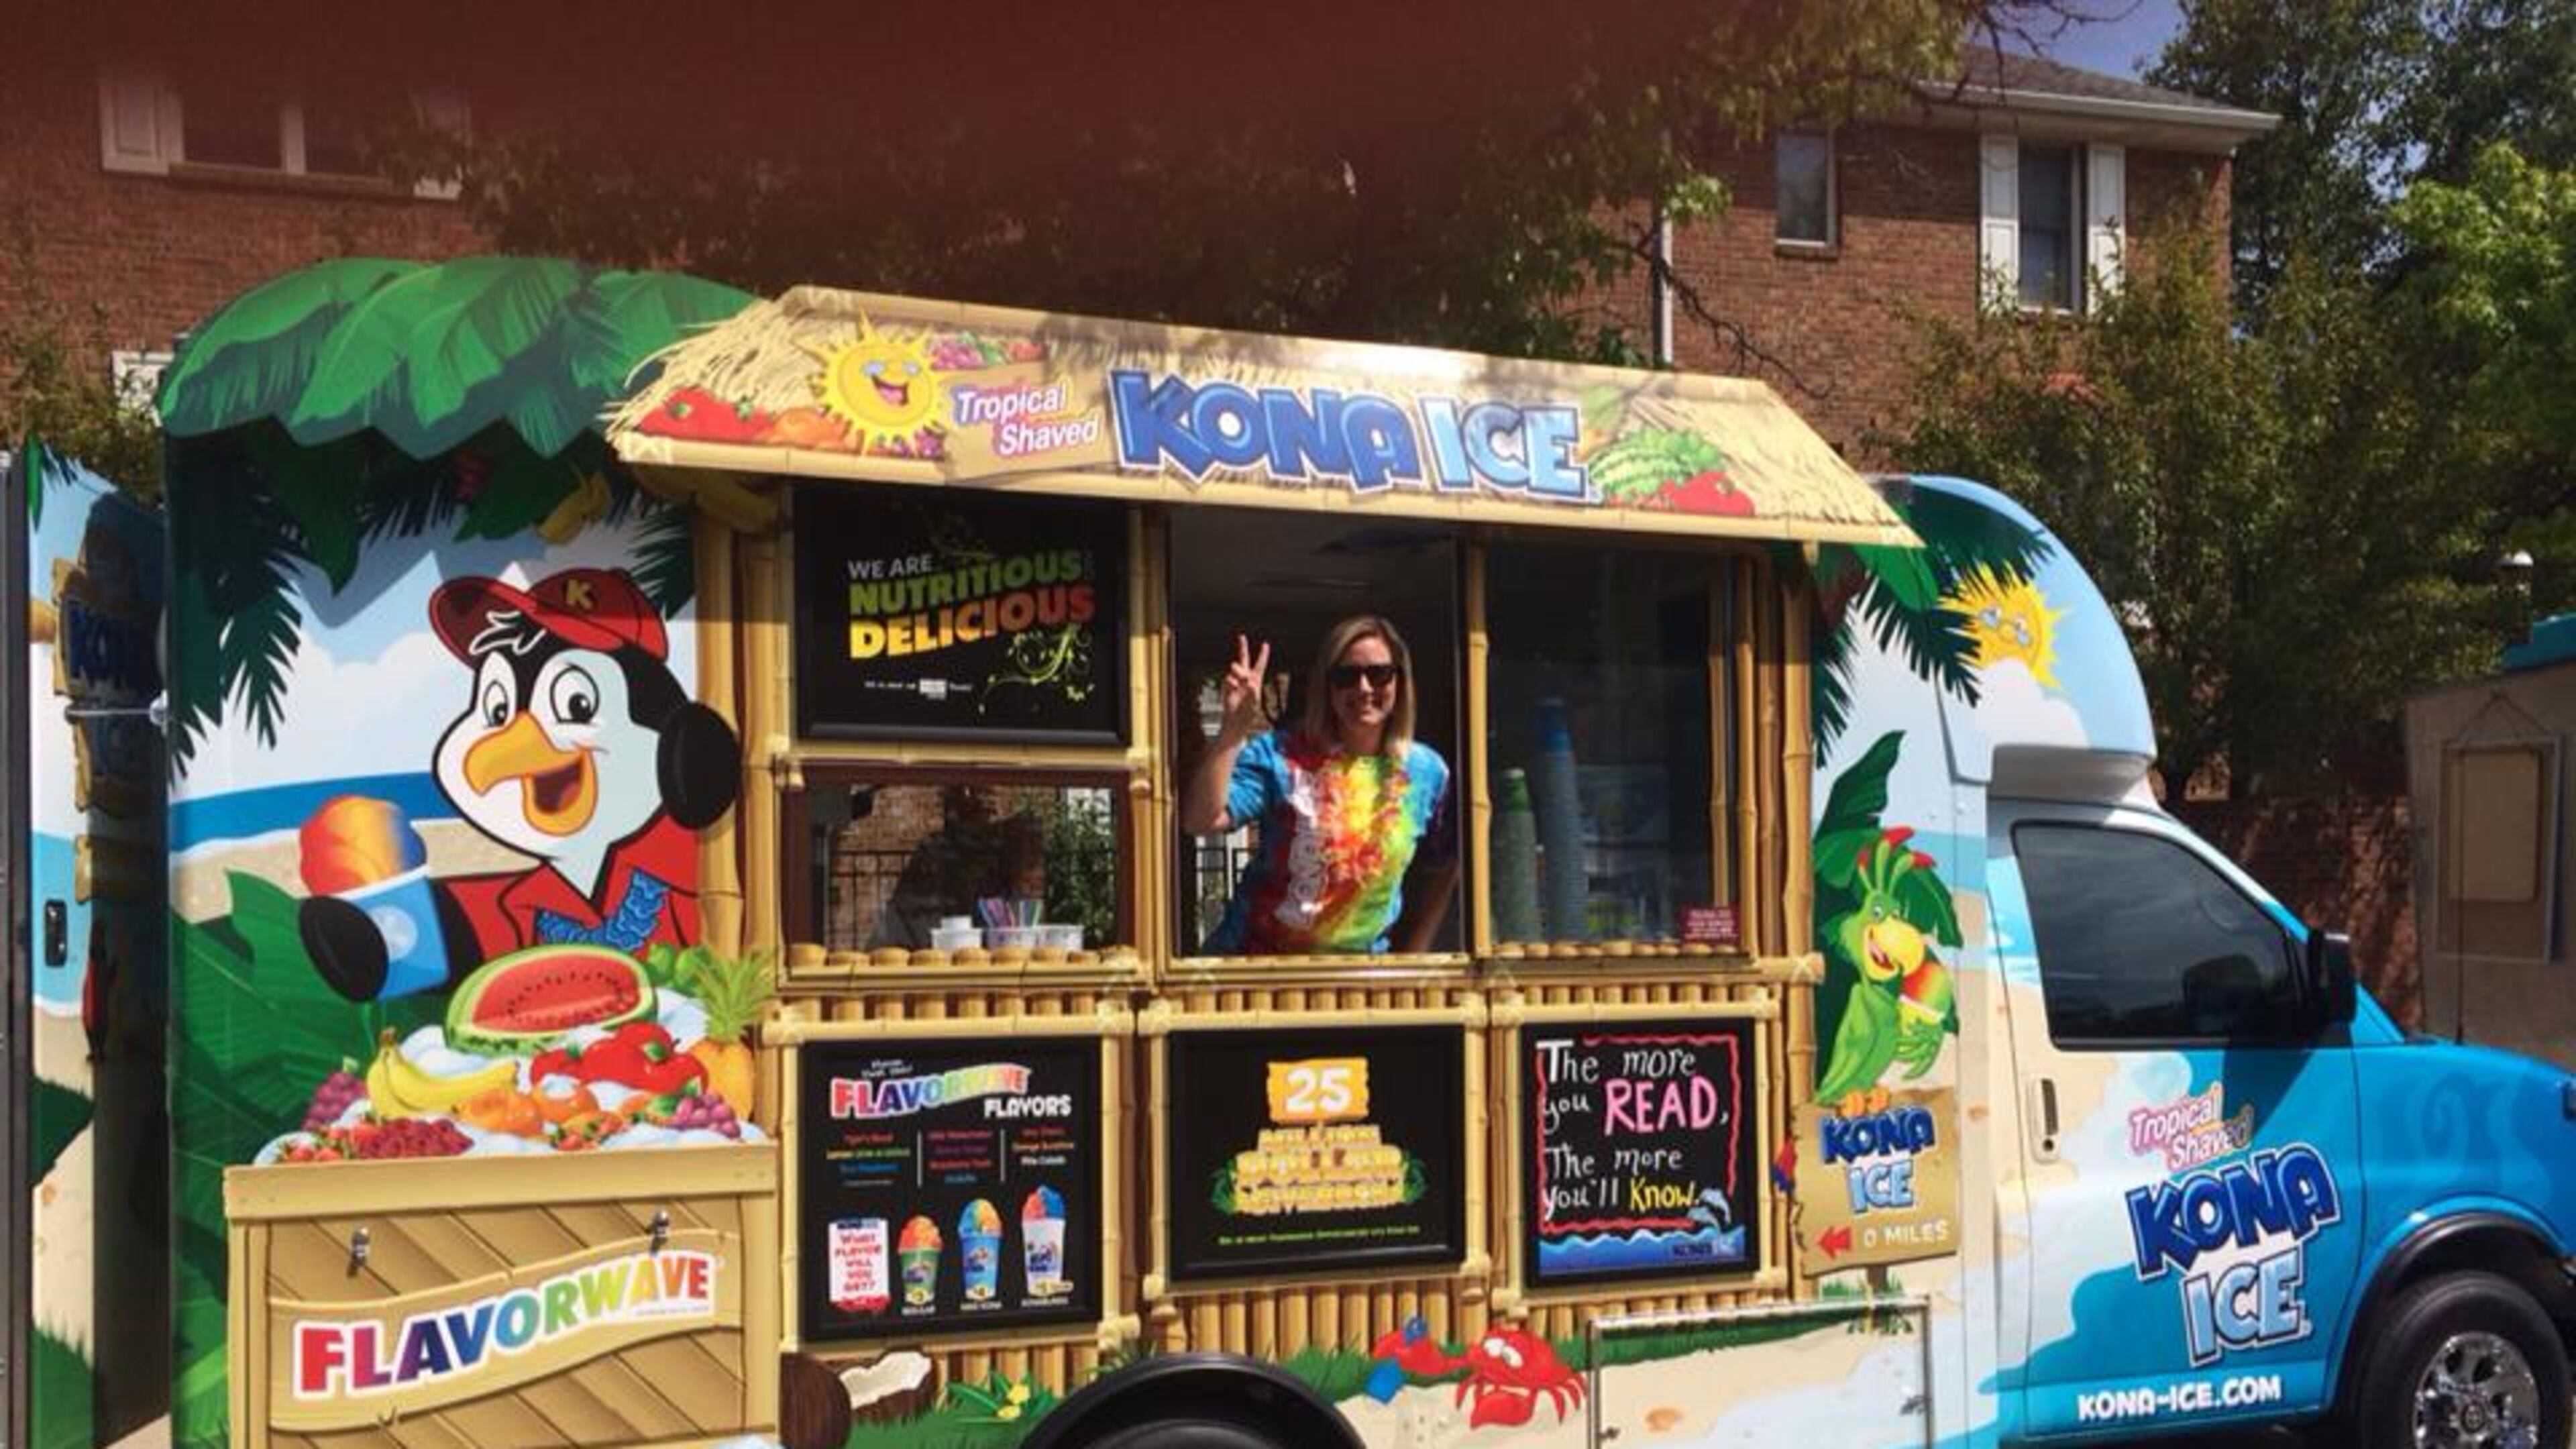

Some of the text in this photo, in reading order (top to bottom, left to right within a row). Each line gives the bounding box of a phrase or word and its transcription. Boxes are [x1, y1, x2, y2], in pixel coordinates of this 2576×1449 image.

[957, 382, 1067, 424] Tropical
[999, 416, 1099, 456] Shaved
[1110, 368, 1589, 503] KONA ICE
[847, 555, 933, 579] WE ARE
[850, 551, 1082, 615] NUTRITIOUS
[565, 579, 594, 609] K
[850, 582, 1094, 659] DELICIOUS
[1536, 1040, 1696, 1083] The more
[983, 1095, 1071, 1118] FLAVORS
[1285, 1067, 1352, 1113] 25
[1543, 1094, 1591, 1136] you
[1821, 1107, 1936, 1164] KONA
[2131, 1083, 2223, 1146] Tropical
[1543, 1142, 1682, 1179] The more
[2170, 1106, 2252, 1170] Shaved
[1543, 1177, 1619, 1222] you'll
[1849, 1159, 1915, 1214] ICE
[1884, 1218, 1949, 1244] MILES
[2125, 1144, 2341, 1281] KONA
[299, 1254, 710, 1393] FLAVORWAVE
[2180, 1245, 2304, 1368] ICE
[2077, 1375, 2282, 1421] KONA-ICE.COM
